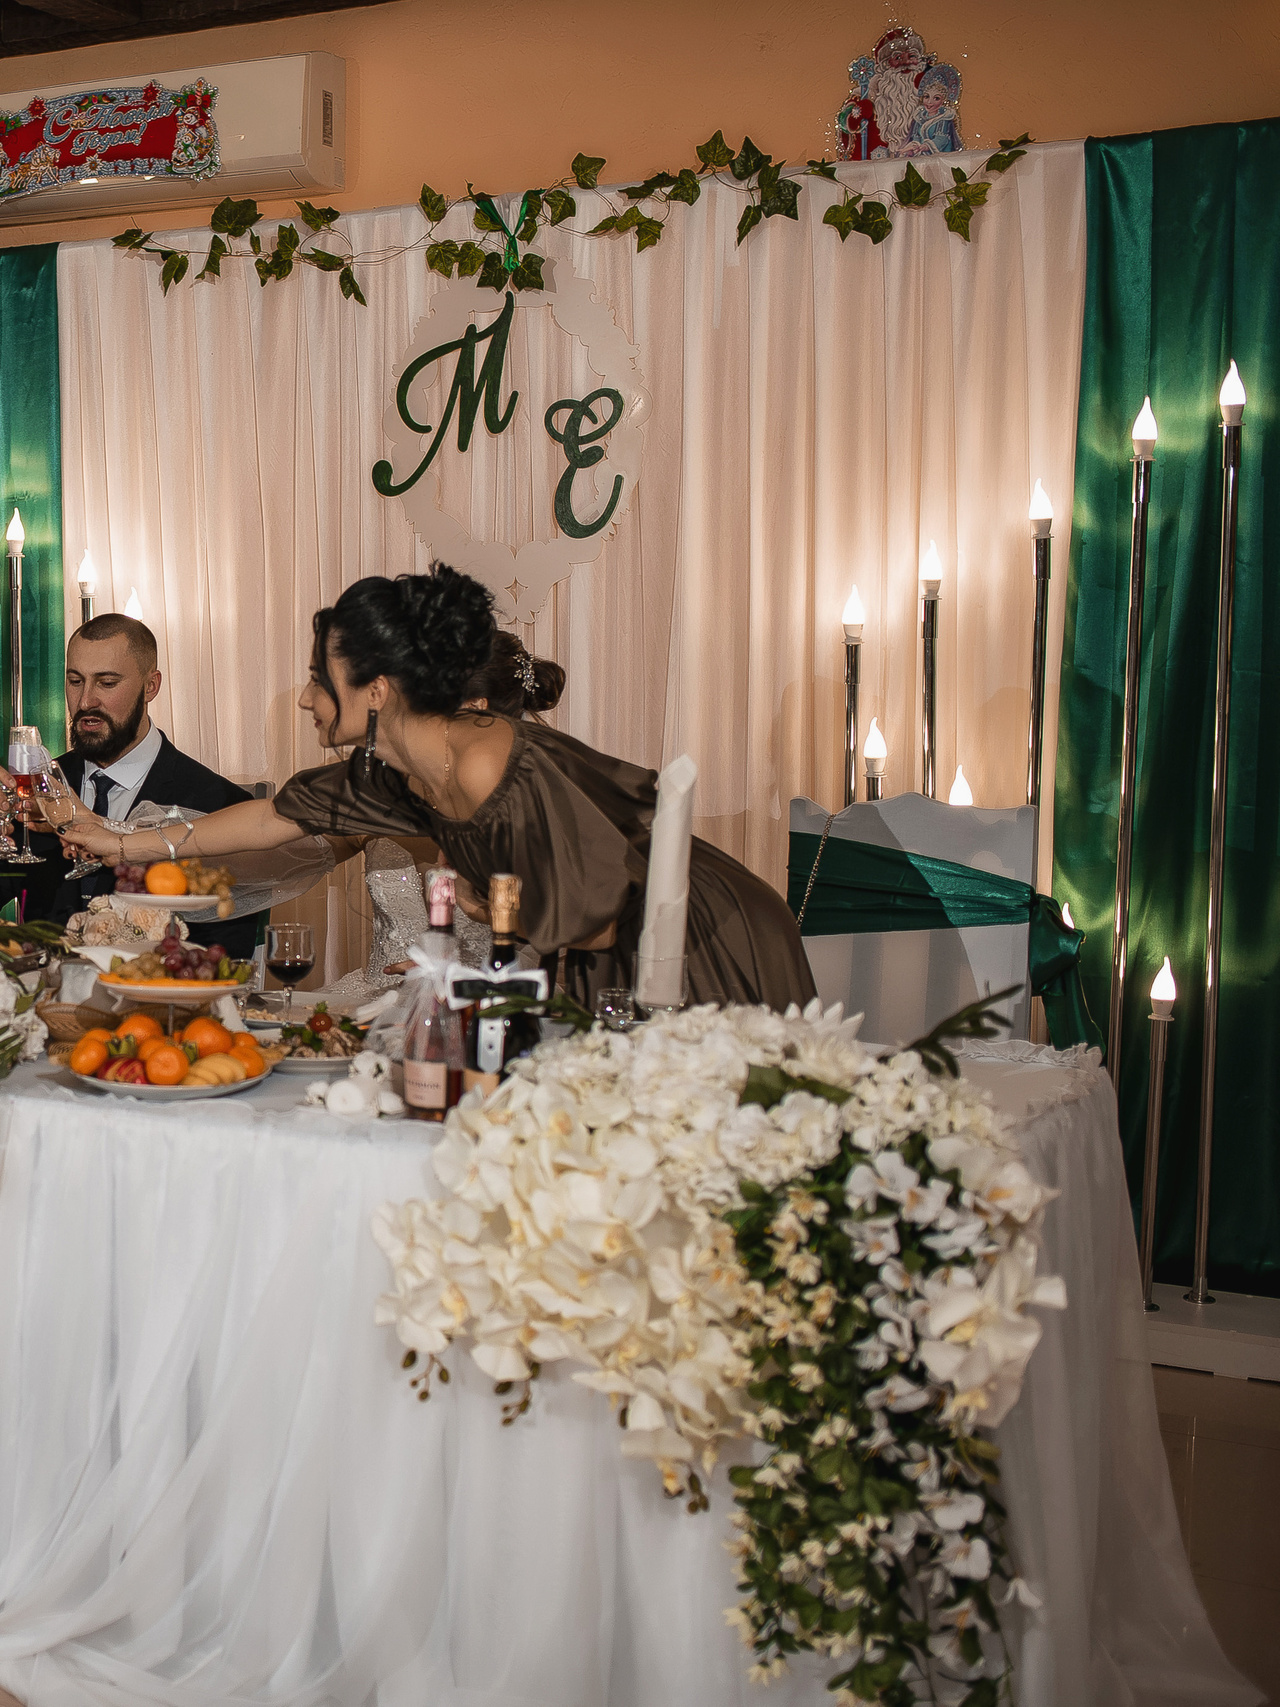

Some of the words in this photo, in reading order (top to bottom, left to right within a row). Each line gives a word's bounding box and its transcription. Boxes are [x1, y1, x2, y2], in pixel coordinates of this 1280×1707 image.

[43, 104, 78, 144] С
[81, 101, 174, 130] Новым
[71, 122, 147, 154] Годом!
